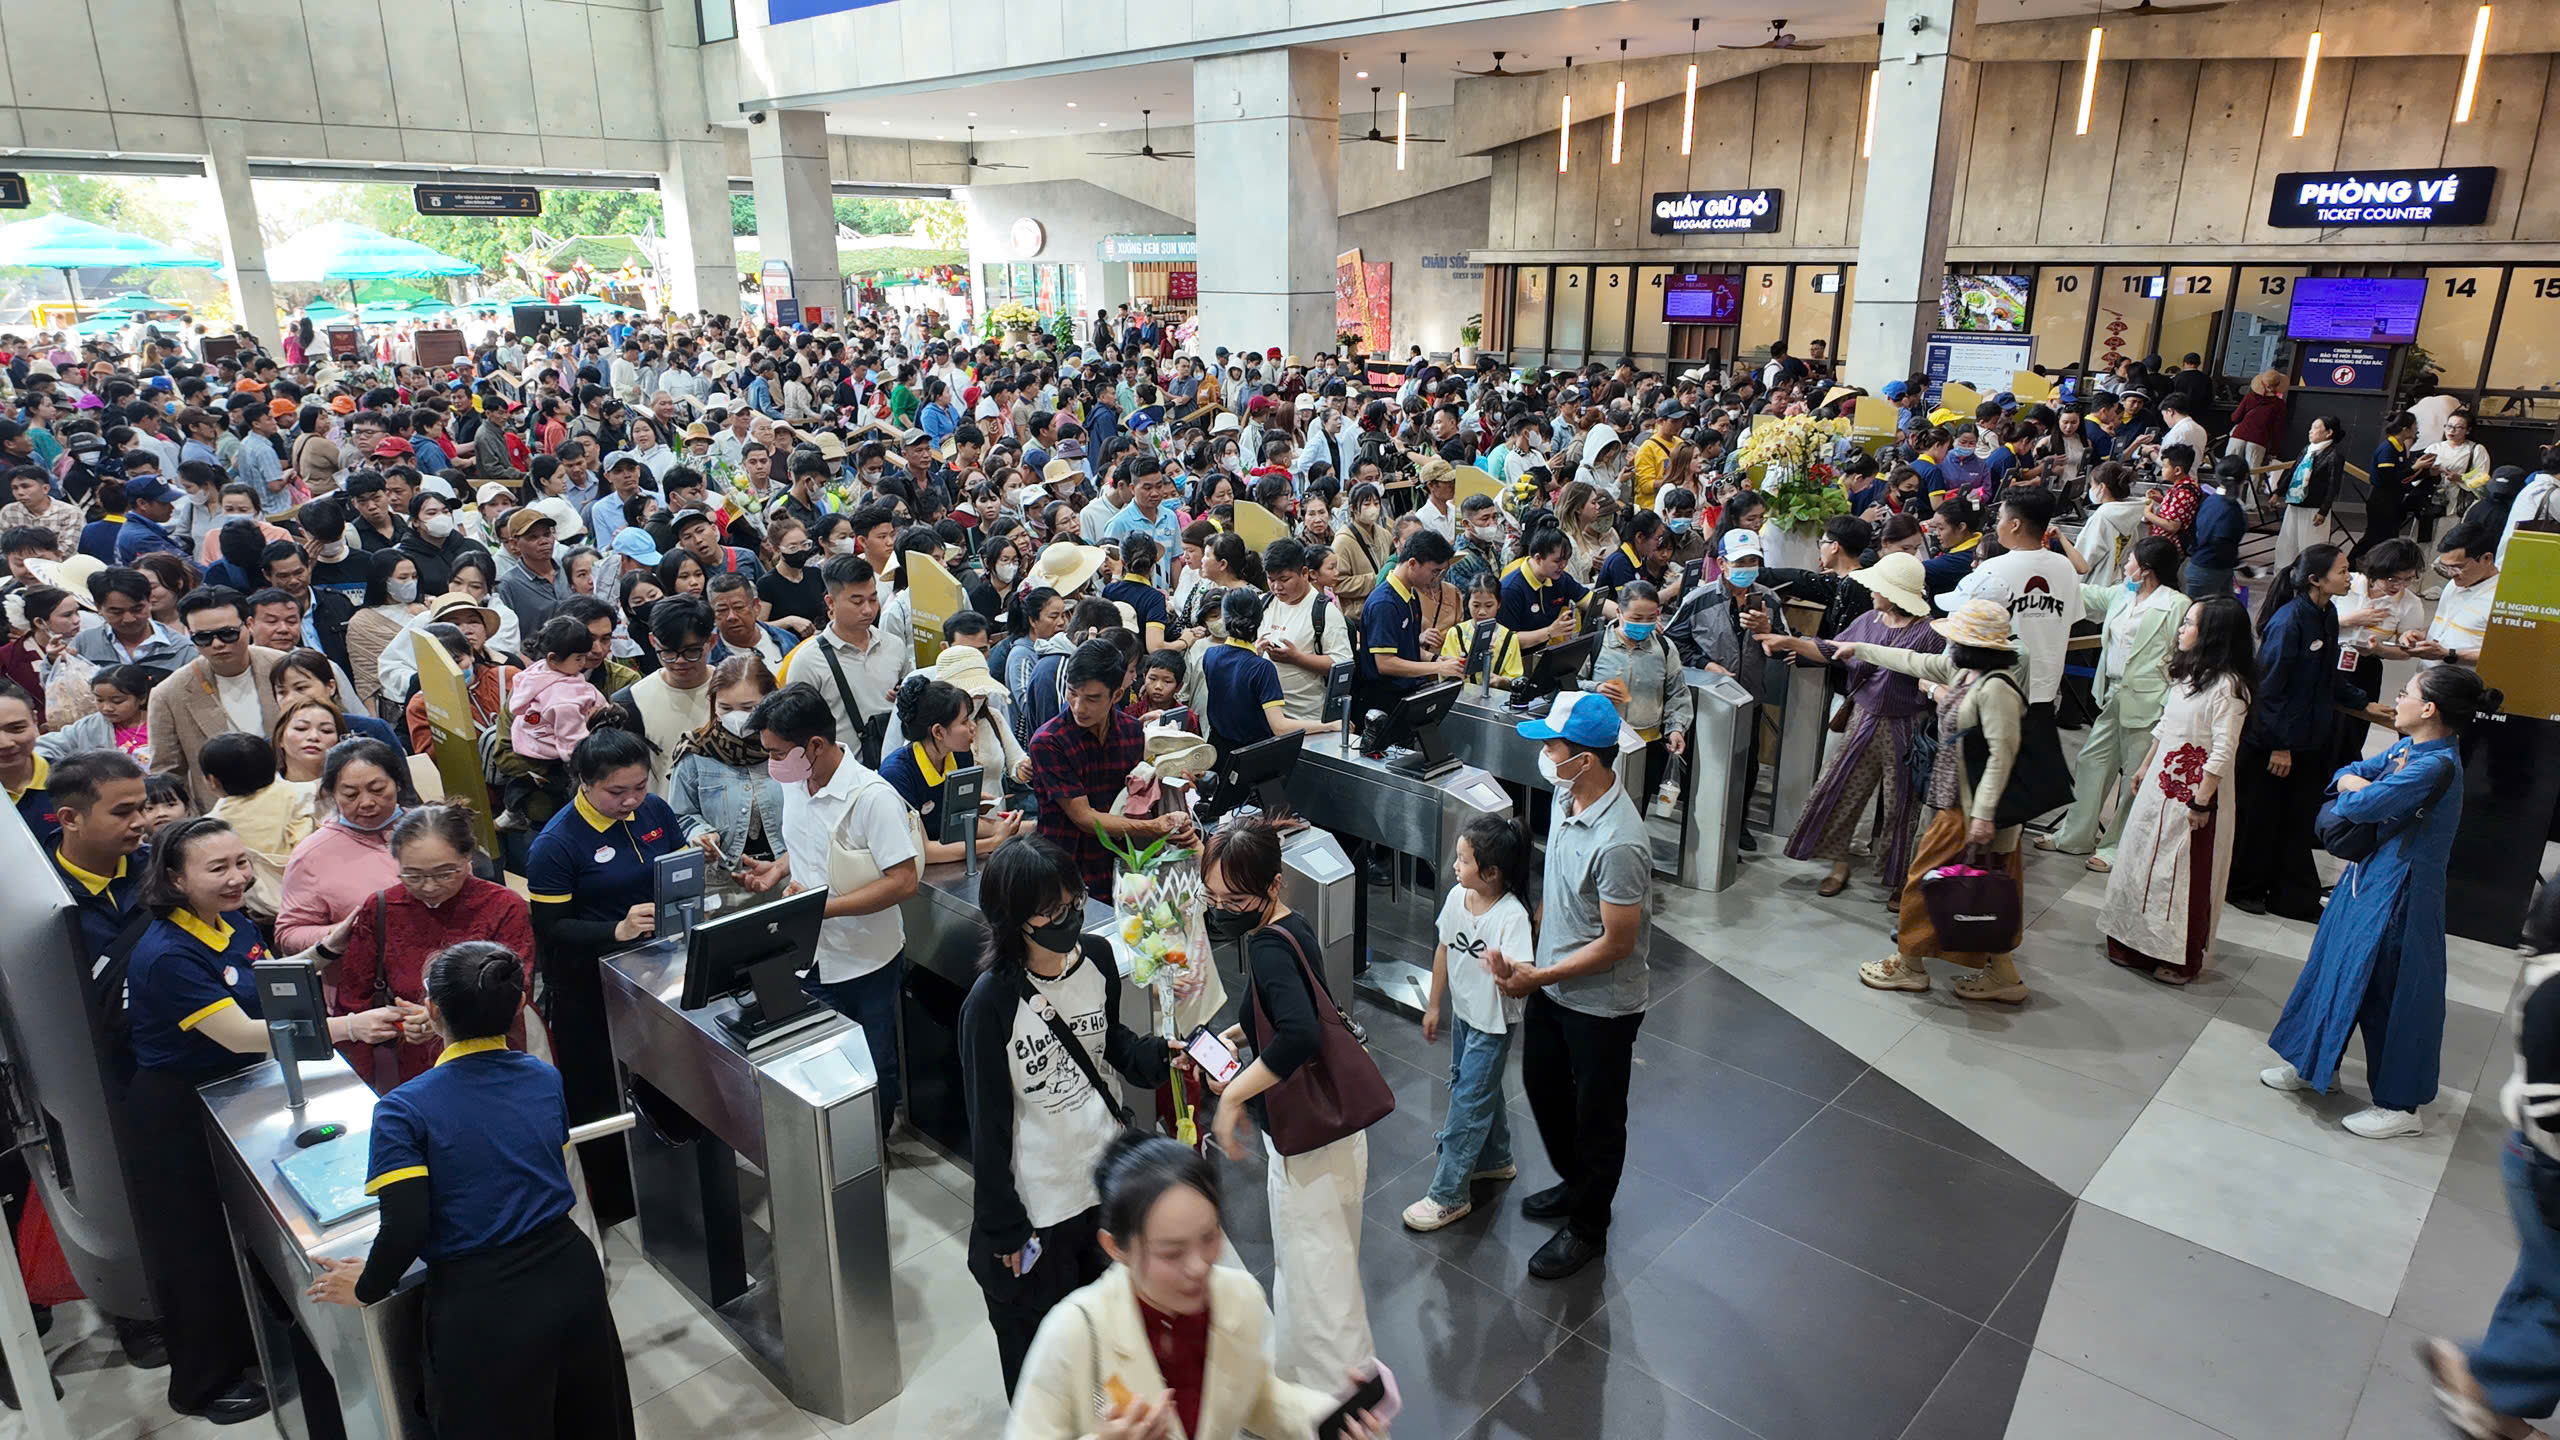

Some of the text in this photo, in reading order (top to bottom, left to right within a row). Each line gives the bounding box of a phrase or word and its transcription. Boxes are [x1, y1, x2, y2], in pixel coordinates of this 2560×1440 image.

[2299, 174, 2459, 204] PHÒNG VÉ
[1705, 195, 1738, 216] GIỮ
[2317, 206, 2432, 221] TICKET COUNTER
[1673, 218, 1752, 229] LUGGAGE COUNTER
[1143, 241, 1160, 255] KEM
[1161, 241, 1176, 255] SUN
[1176, 241, 1196, 255] WOR
[1530, 274, 1538, 287] 1
[1569, 274, 1578, 287] 2
[1609, 274, 1619, 287] 3
[1651, 274, 1662, 288] 4
[1761, 274, 1773, 288] 5
[2055, 275, 2078, 292] 10
[2122, 276, 2142, 293] 11
[2187, 276, 2212, 293] 12
[2259, 276, 2286, 294] 13
[2445, 278, 2477, 297] 14
[2533, 278, 2560, 298] 15
[2495, 601, 2506, 609] VÉ
[2492, 616, 2537, 628] VÉ TRẺ EM
[1026, 1054, 1048, 1075] 69
